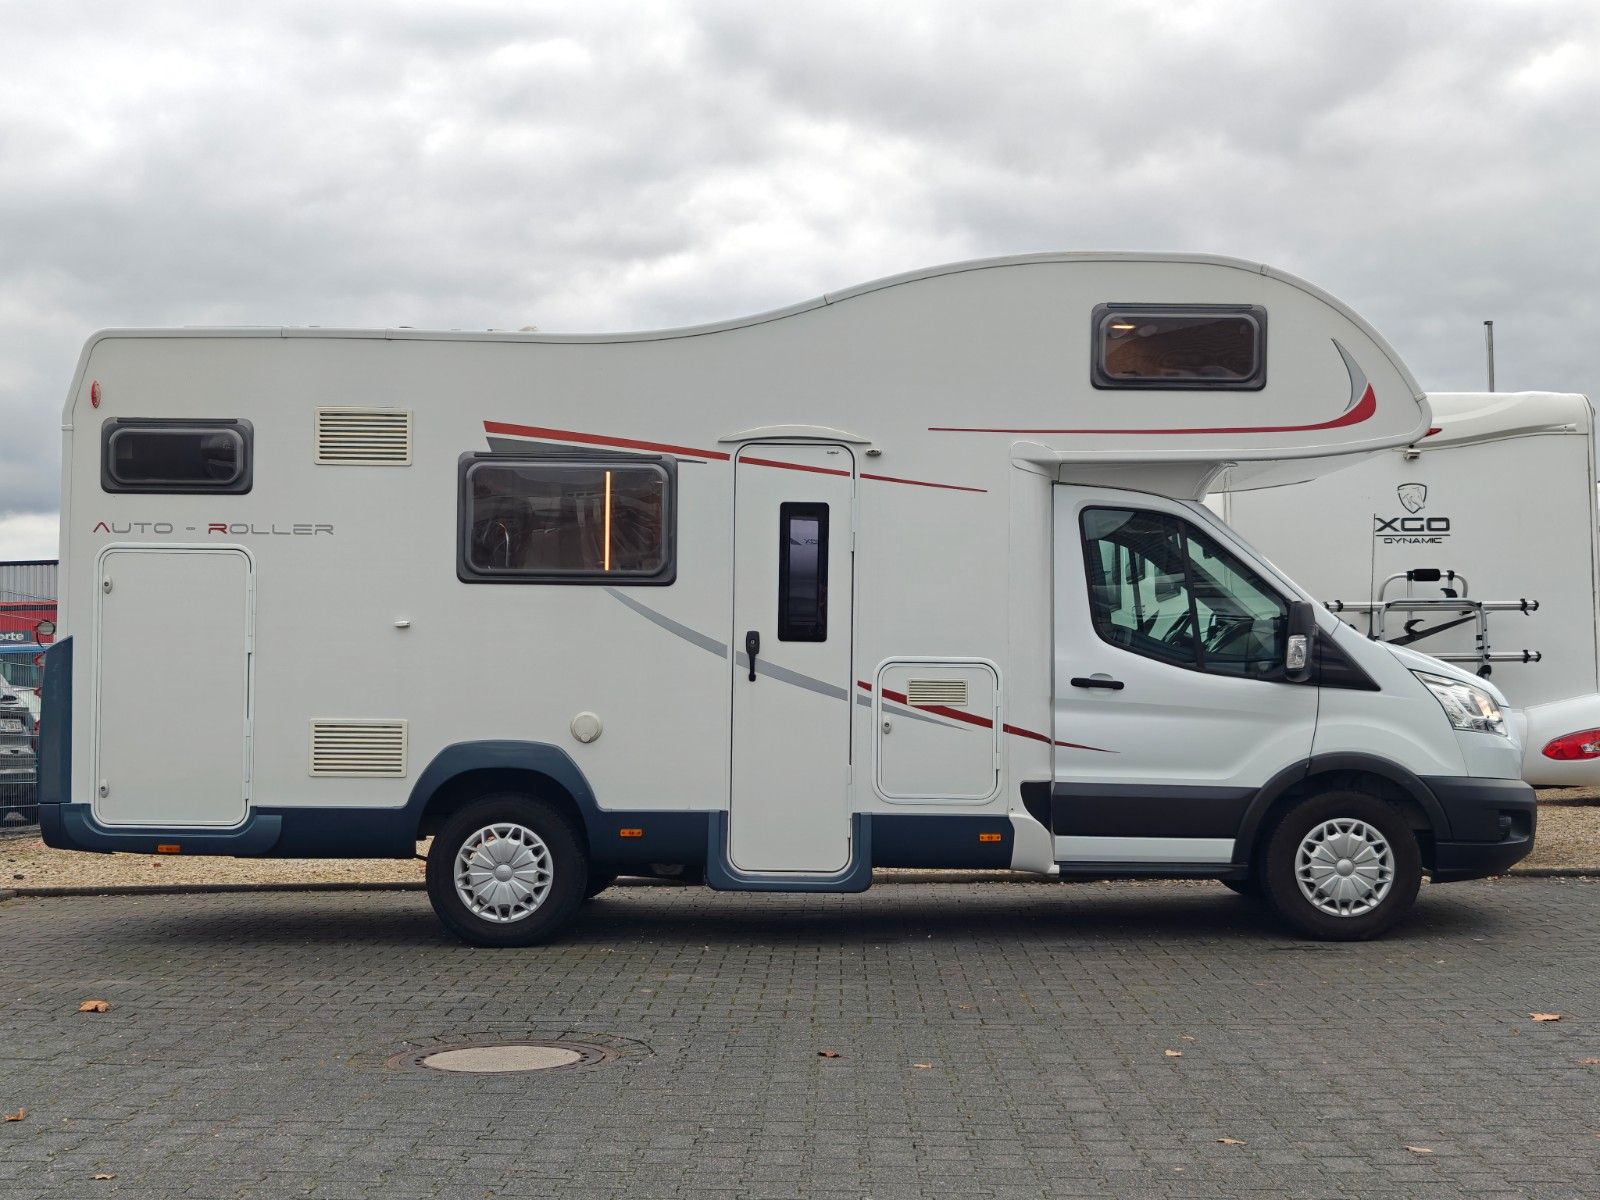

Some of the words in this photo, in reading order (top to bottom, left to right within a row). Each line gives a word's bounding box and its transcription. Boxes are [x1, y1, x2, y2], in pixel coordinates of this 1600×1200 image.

[93, 521, 174, 534] AUTO
[208, 523, 334, 536] ROLLER
[1375, 517, 1450, 532] XGO
